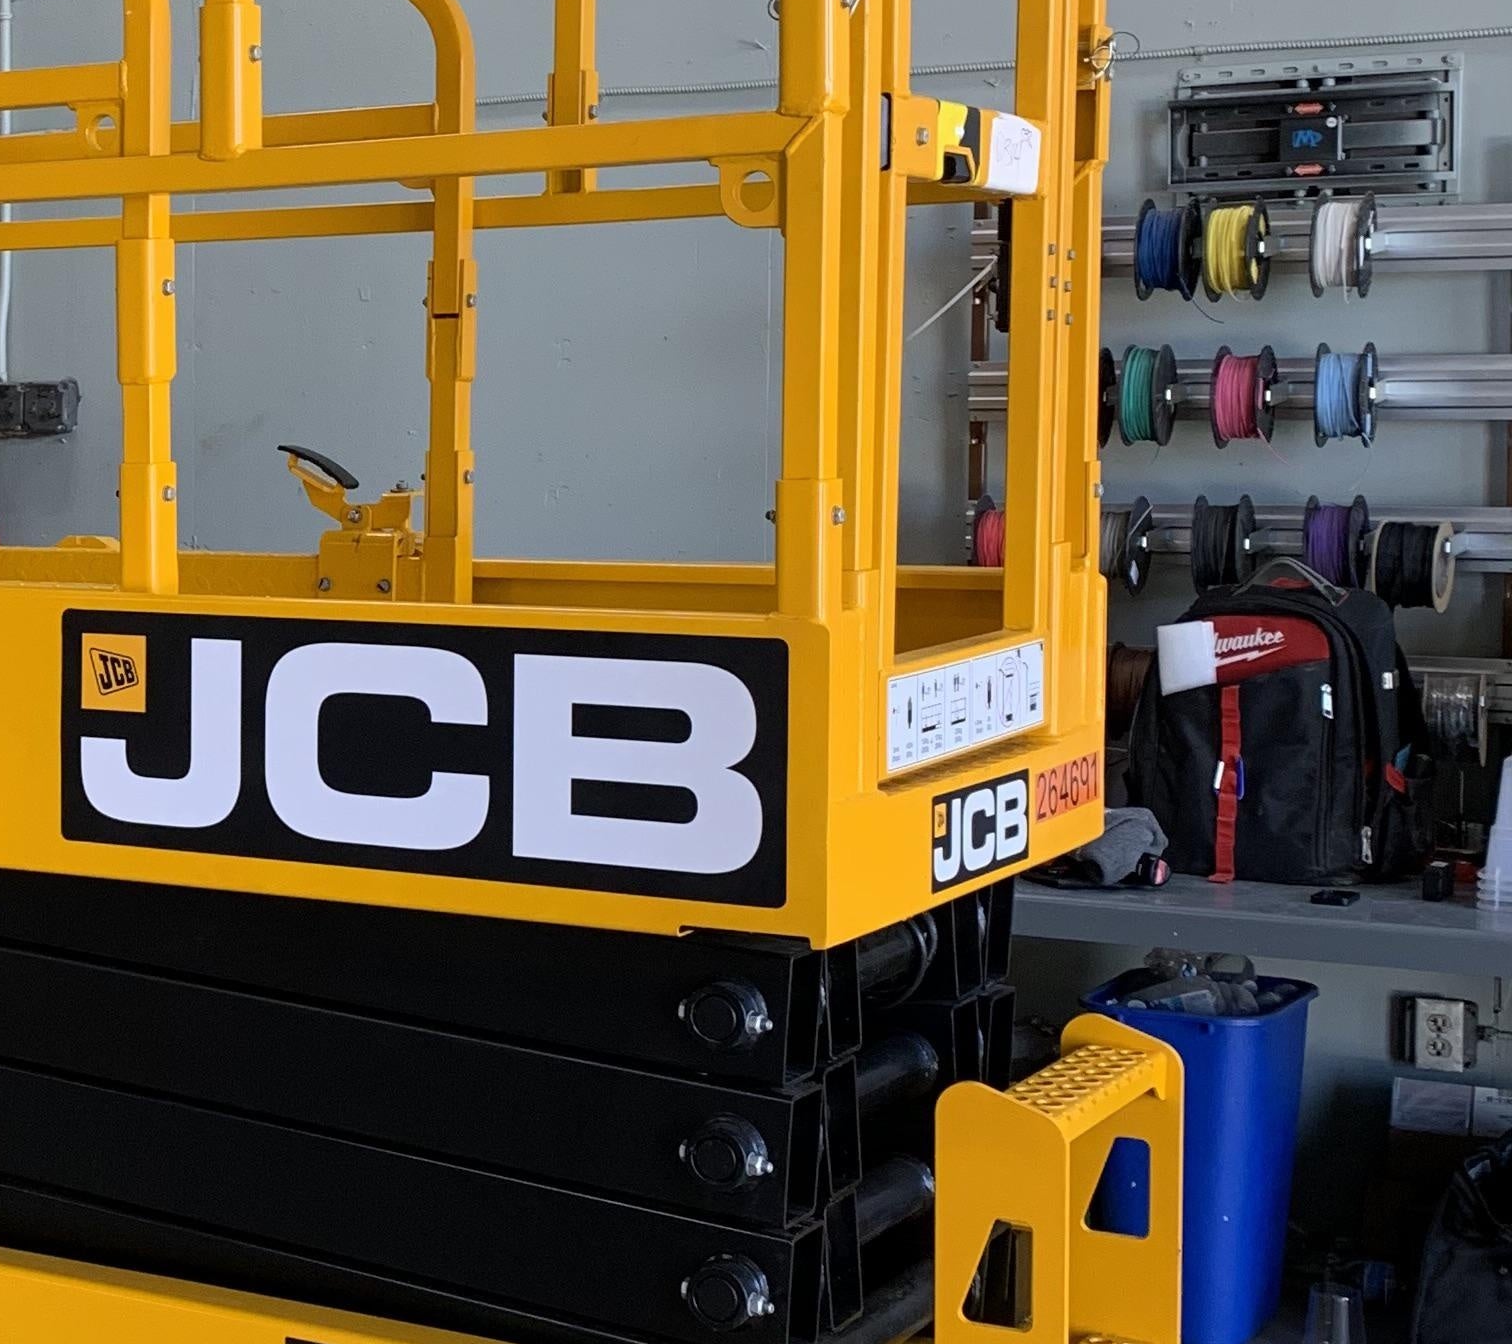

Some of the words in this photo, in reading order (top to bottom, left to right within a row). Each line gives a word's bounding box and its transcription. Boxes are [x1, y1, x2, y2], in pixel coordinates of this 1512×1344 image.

[98, 653, 135, 690] JCB
[1214, 627, 1285, 654] lwaukee
[80, 637, 763, 874] JCB
[1037, 752, 1098, 820] 264691
[933, 778, 1028, 882] JCB
